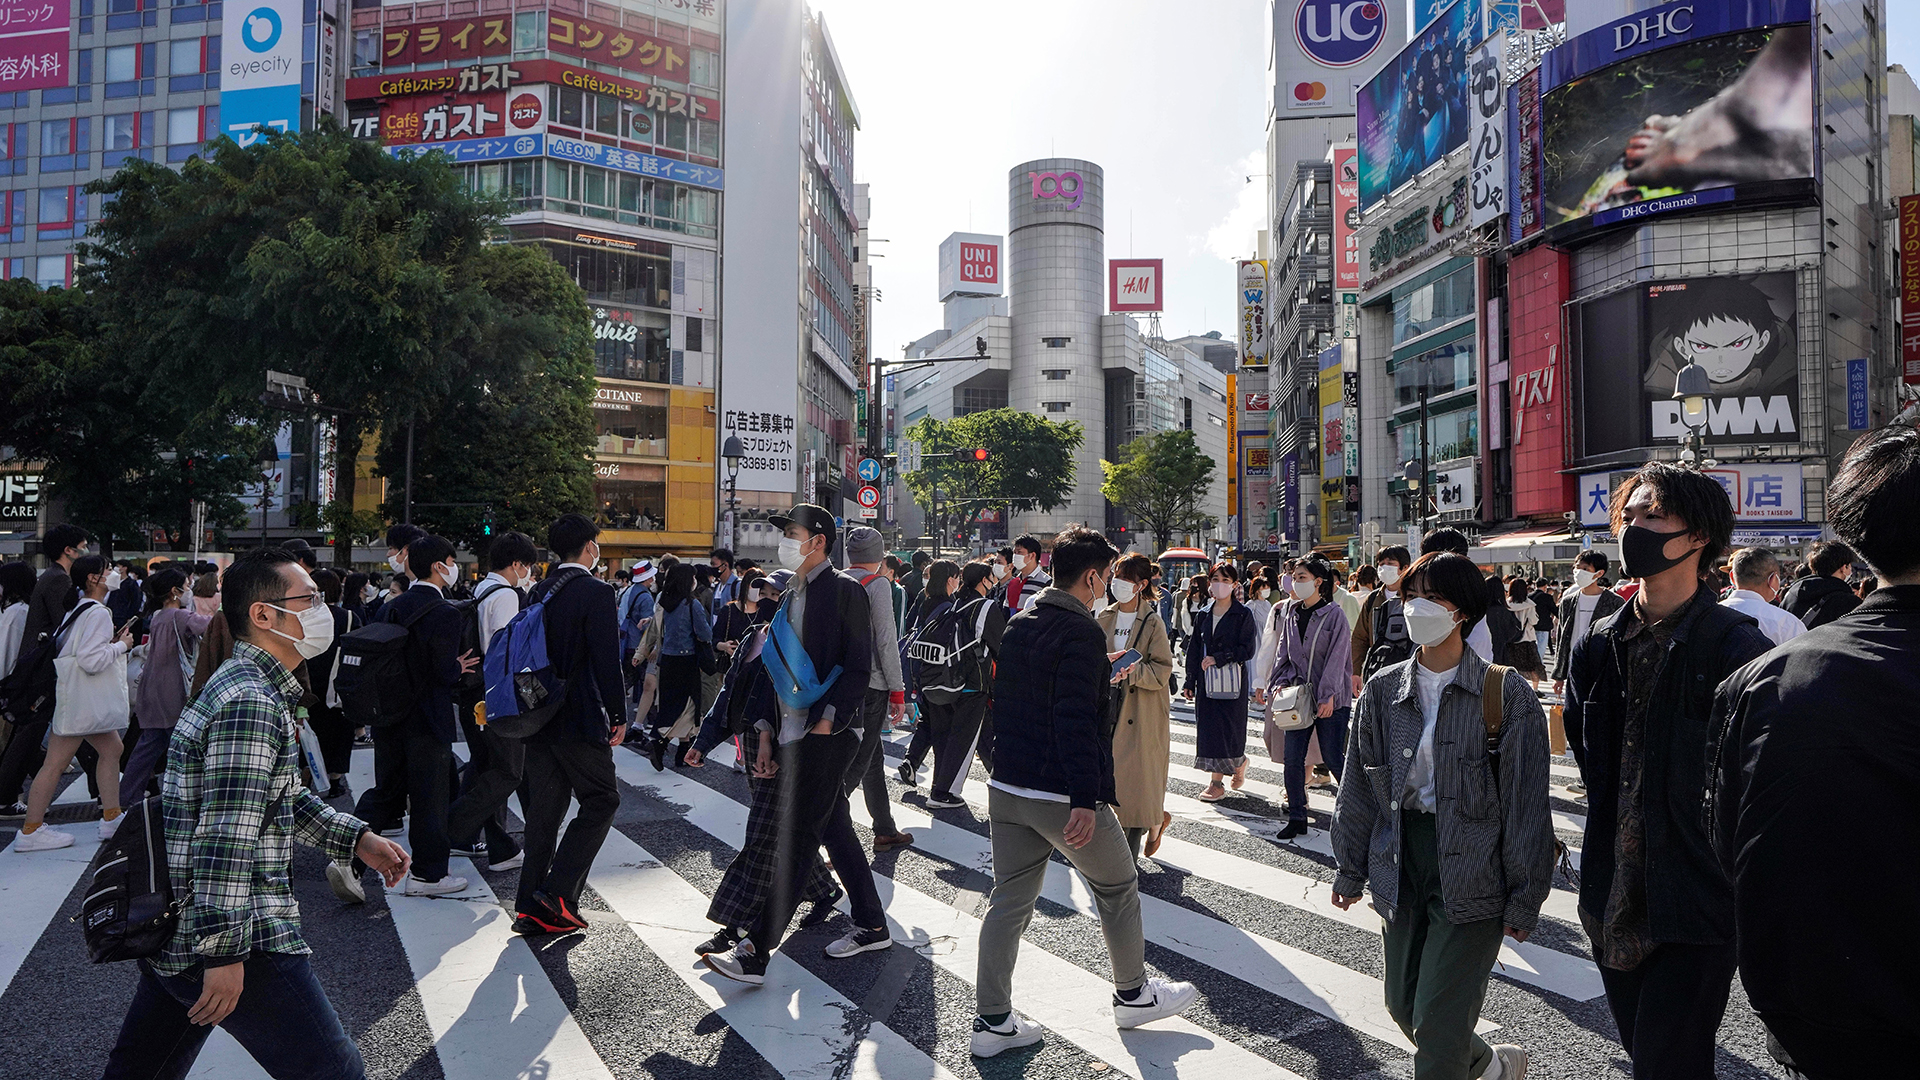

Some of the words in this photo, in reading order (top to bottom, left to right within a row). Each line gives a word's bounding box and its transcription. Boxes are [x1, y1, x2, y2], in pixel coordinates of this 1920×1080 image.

[385, 19, 508, 57] プライス
[1613, 5, 1694, 52] DHC
[549, 16, 684, 72] コンタクト
[0, 52, 61, 81] 容外科
[230, 55, 292, 79] eyecity
[458, 63, 520, 93] ガスト
[646, 87, 708, 119] ガスト
[351, 116, 380, 138] 7F
[386, 112, 419, 129] Café
[422, 103, 499, 141] ガスト
[1472, 44, 1503, 213] もんじゃ
[516, 139, 533, 153] 6F
[555, 140, 596, 160] AEON
[1028, 171, 1084, 211] 109
[1622, 204, 1648, 219] DHC
[1649, 194, 1698, 213] Channel
[964, 247, 991, 263] UNI
[1902, 199, 1920, 305] クスリのことなら
[964, 263, 994, 280] QLO
[1122, 276, 1150, 294] H&M
[593, 402, 630, 411] PROVENCE
[725, 410, 794, 435] 広告主募集中
[739, 436, 793, 454] ミプロジェクト
[1288, 460, 1297, 487] MIZUHO
